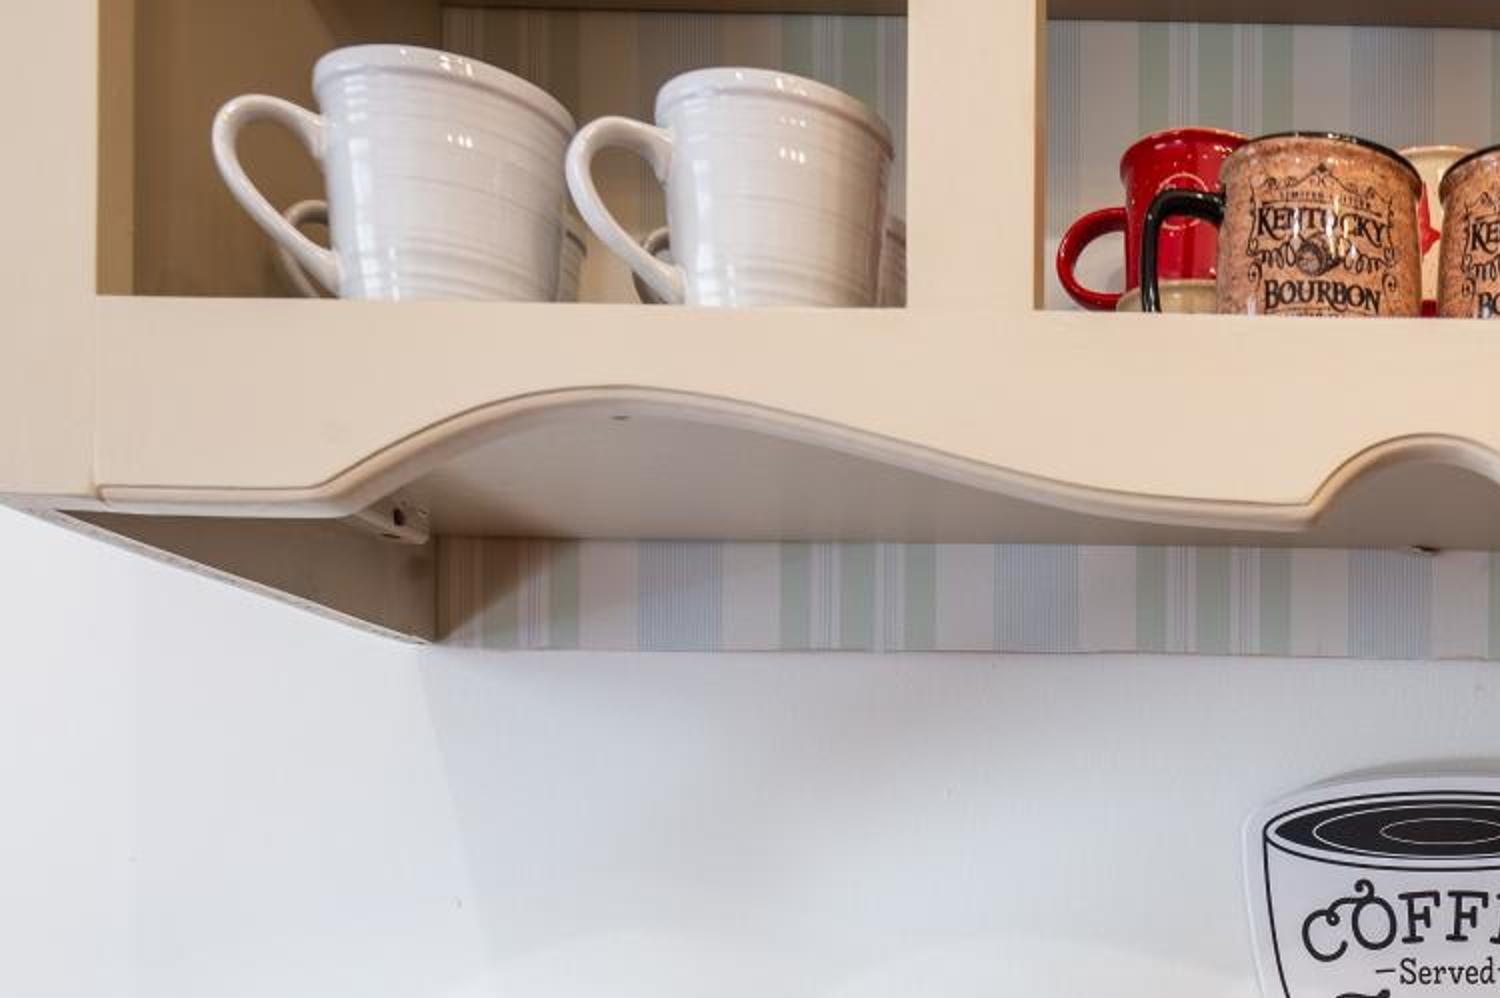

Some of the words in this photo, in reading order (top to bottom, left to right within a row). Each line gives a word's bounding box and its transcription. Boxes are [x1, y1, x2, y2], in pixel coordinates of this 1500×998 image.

[1257, 206, 1385, 248] KENTUCKY
[1264, 279, 1381, 315] BOURBON
[1399, 957, 1497, 985] Served
